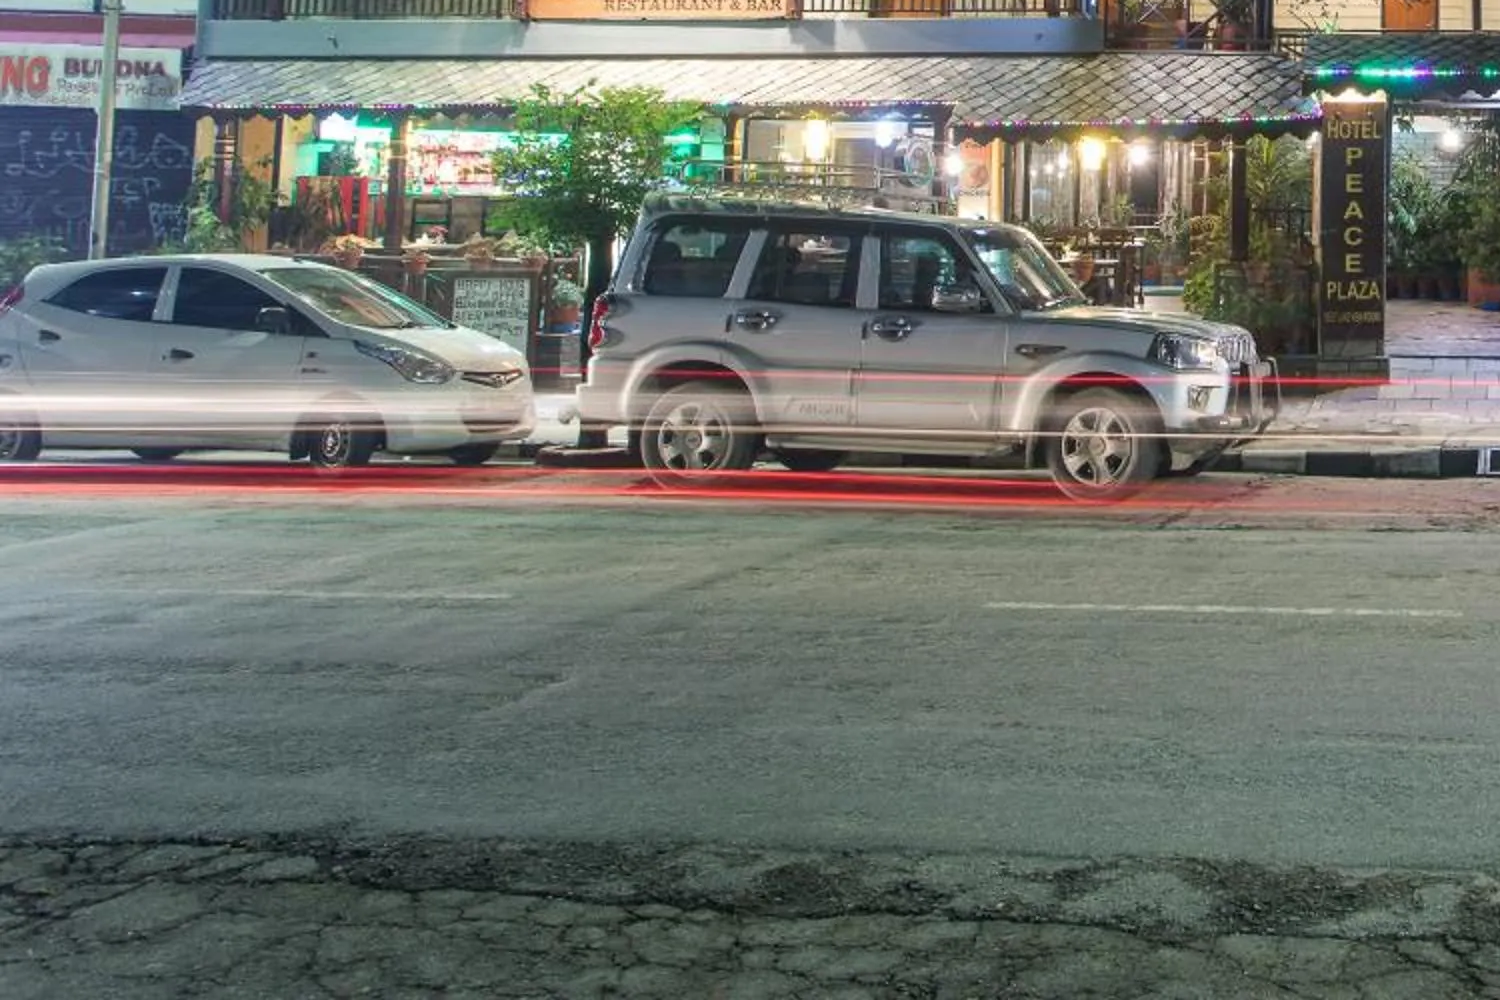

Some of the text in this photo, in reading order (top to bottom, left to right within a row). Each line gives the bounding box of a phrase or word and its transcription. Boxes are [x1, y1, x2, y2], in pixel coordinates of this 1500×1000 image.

[604, 0, 783, 12] RESTAURANT & BAR
[1326, 120, 1382, 140] HOTEL
[1343, 147, 1364, 274] PEACE
[1326, 281, 1381, 300] PLAZA
